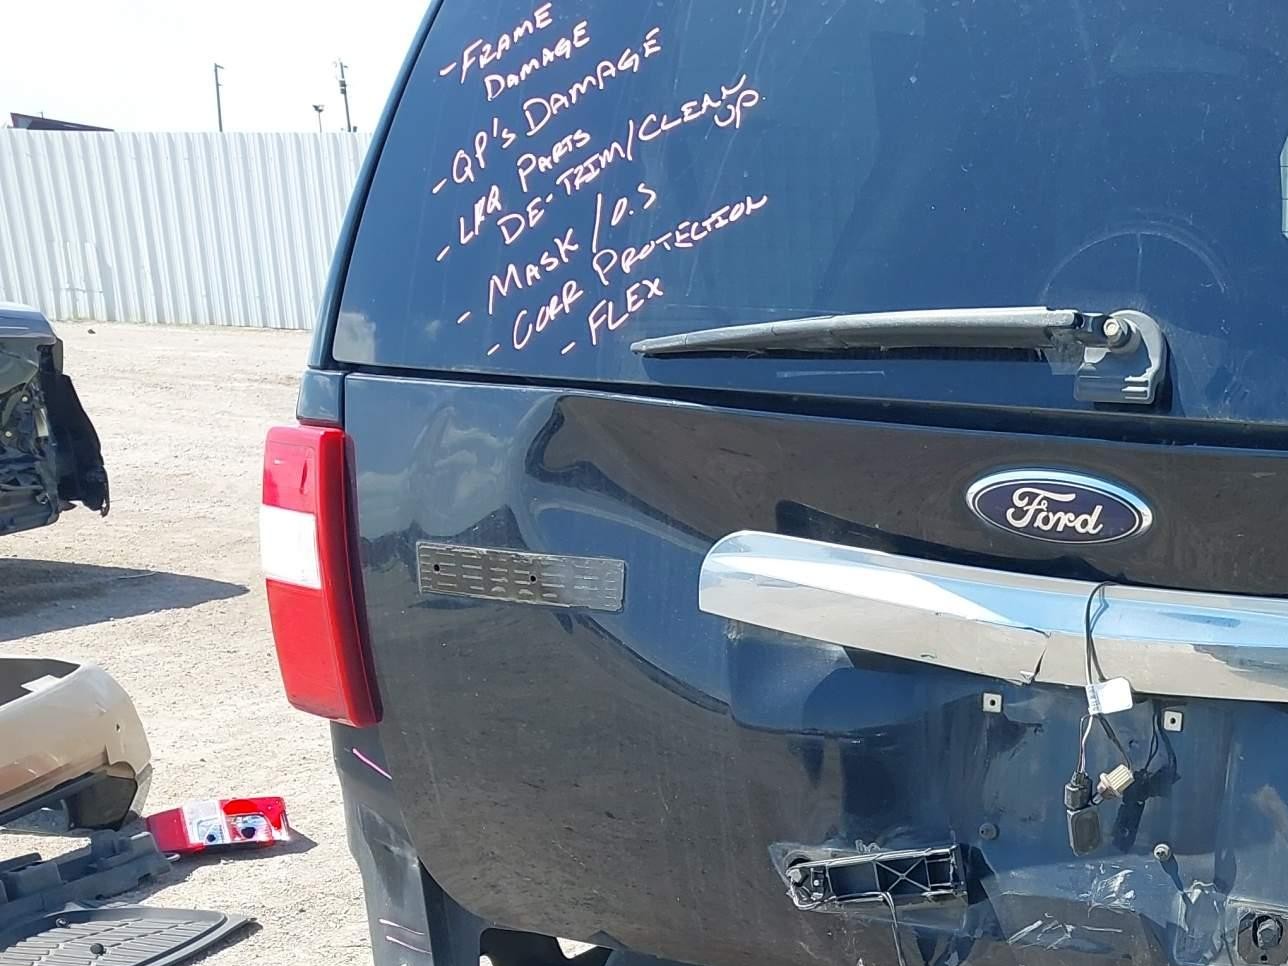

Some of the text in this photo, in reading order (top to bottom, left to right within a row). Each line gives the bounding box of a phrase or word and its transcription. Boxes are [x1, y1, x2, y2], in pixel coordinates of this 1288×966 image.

[523, 27, 662, 136] DAMAGE
[488, 228, 579, 314] MASK
[592, 195, 768, 286] PROTECTION
[588, 277, 664, 346] FLEX
[1006, 487, 1104, 535] Ford
